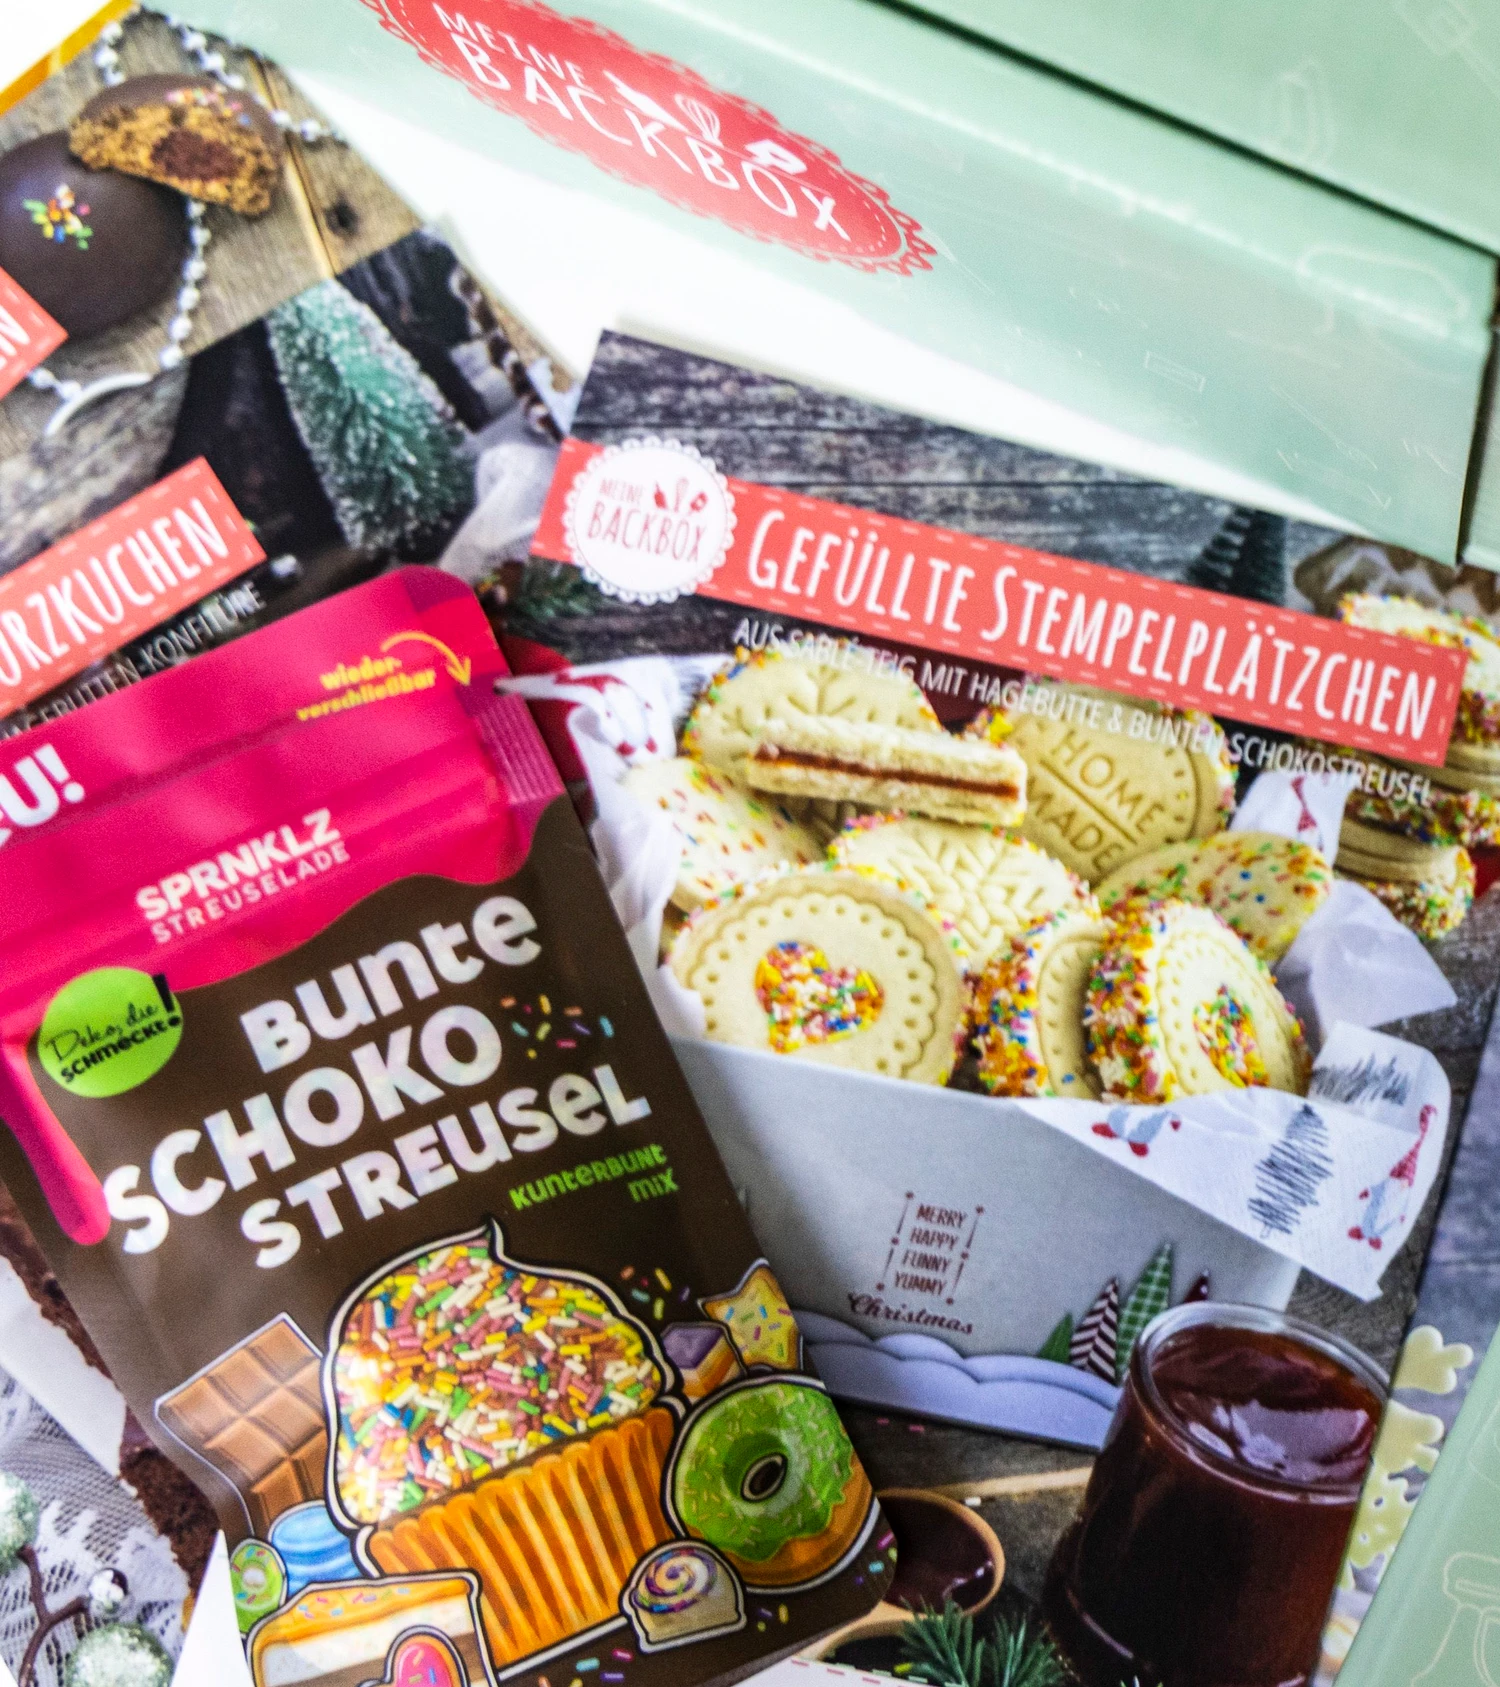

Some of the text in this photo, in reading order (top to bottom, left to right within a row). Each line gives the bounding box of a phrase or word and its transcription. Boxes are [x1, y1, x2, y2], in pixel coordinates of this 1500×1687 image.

[432, 2, 594, 88] MEINE
[451, 32, 852, 242] BACKBOX
[587, 500, 706, 563] BACKBOX
[732, 617, 785, 652] AUS
[919, 659, 968, 697] MIT
[968, 671, 1104, 729] HAGEBUTTE
[1106, 698, 1123, 733] &
[1229, 732, 1432, 808] SCHOKOSTREUSEL
[0, 742, 86, 851] U!
[1050, 728, 1169, 834] HOME
[135, 808, 340, 922] SPRNKLZ
[150, 840, 351, 945] STREUSELADE
[103, 1004, 502, 1254] SCHOKO
[902, 1249, 951, 1274] FUNNY
[909, 1226, 959, 1251] HAPPY
[915, 1203, 967, 1229] MERRY
[847, 1290, 974, 1336] Christmas
[894, 1270, 947, 1296] YUMMY
